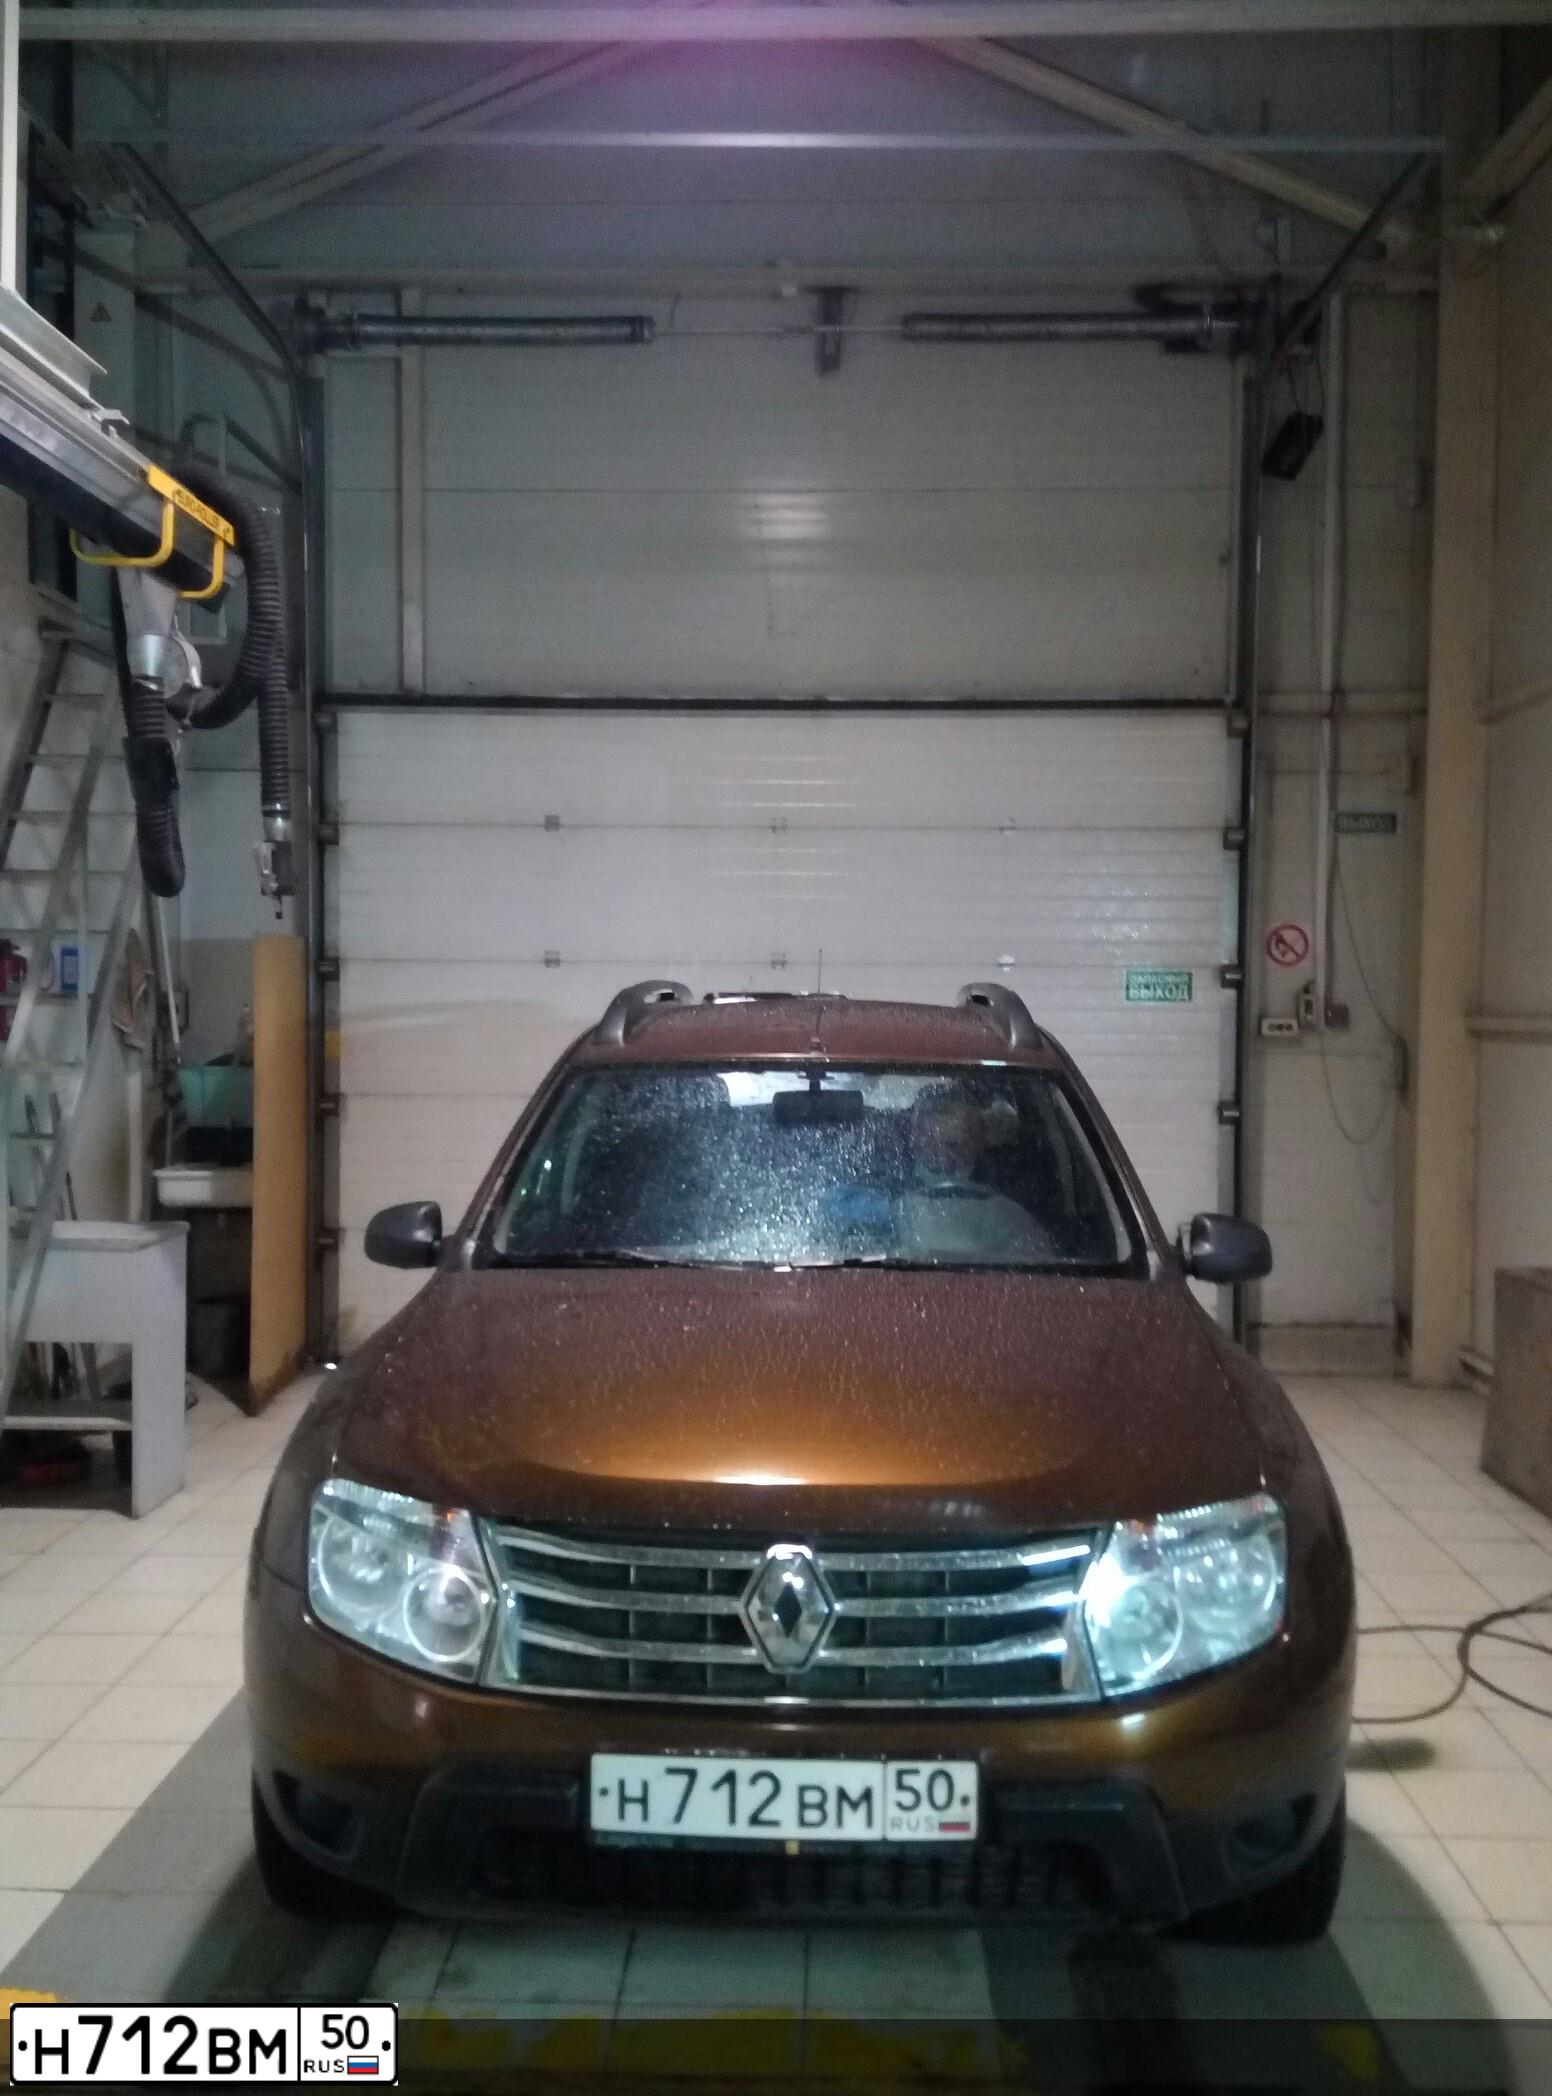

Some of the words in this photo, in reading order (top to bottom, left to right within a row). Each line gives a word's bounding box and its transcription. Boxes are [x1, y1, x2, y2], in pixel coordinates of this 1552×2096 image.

[1129, 984, 1189, 1000] ВЫХОД
[895, 1768, 955, 1811] 50
[890, 1817, 936, 1832] RUS
